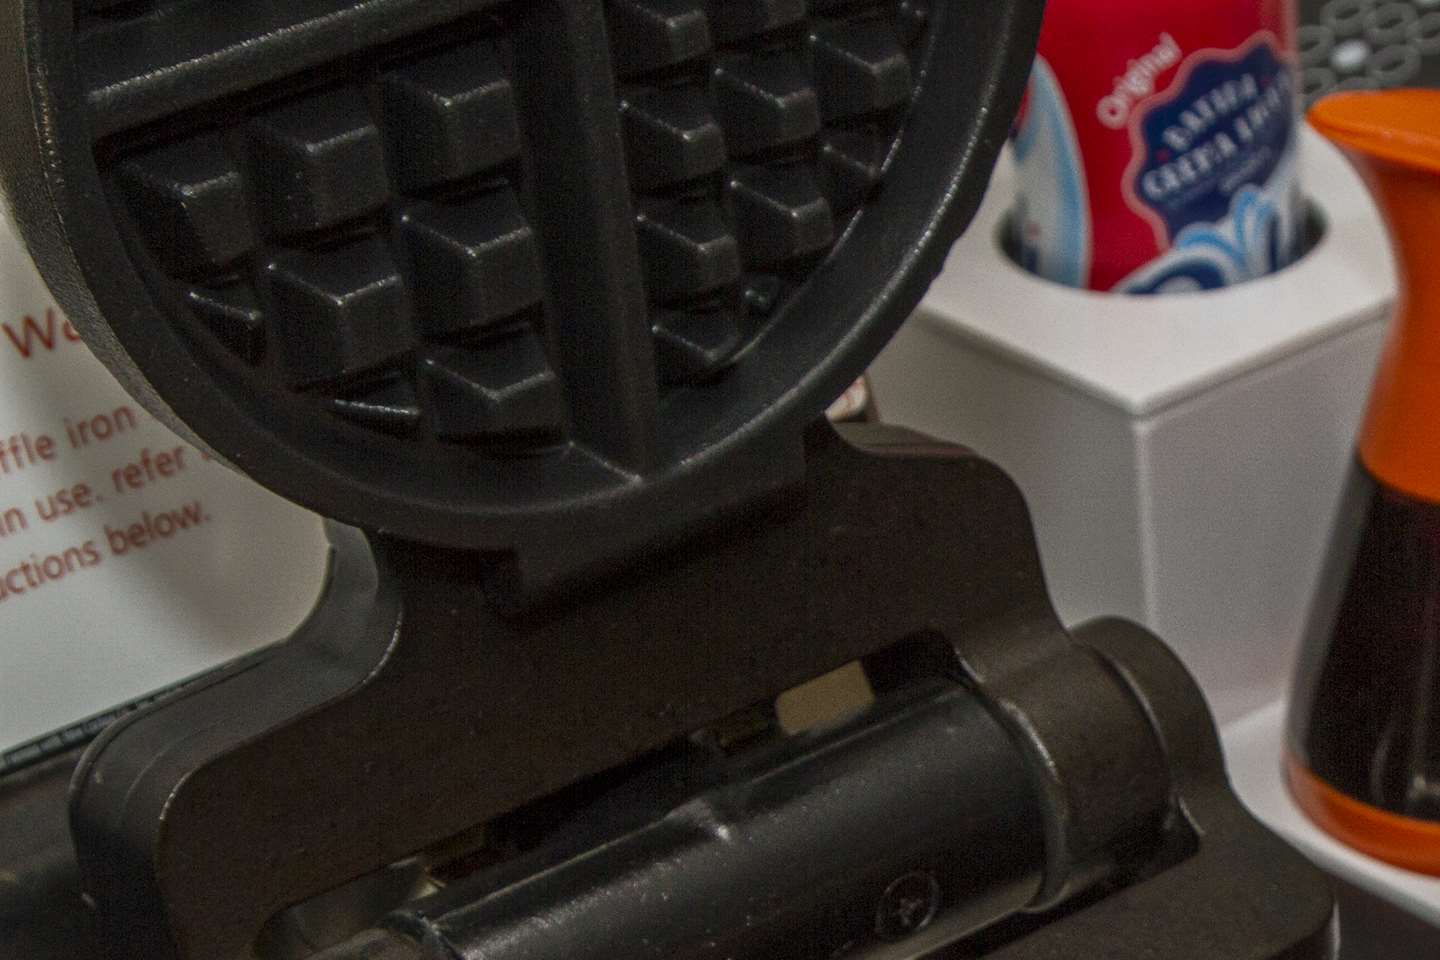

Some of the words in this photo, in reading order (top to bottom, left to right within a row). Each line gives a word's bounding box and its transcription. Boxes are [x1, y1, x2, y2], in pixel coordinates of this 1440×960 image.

[1096, 31, 1182, 129] Original
[64, 405, 138, 448] iron
[112, 446, 185, 493] refer
